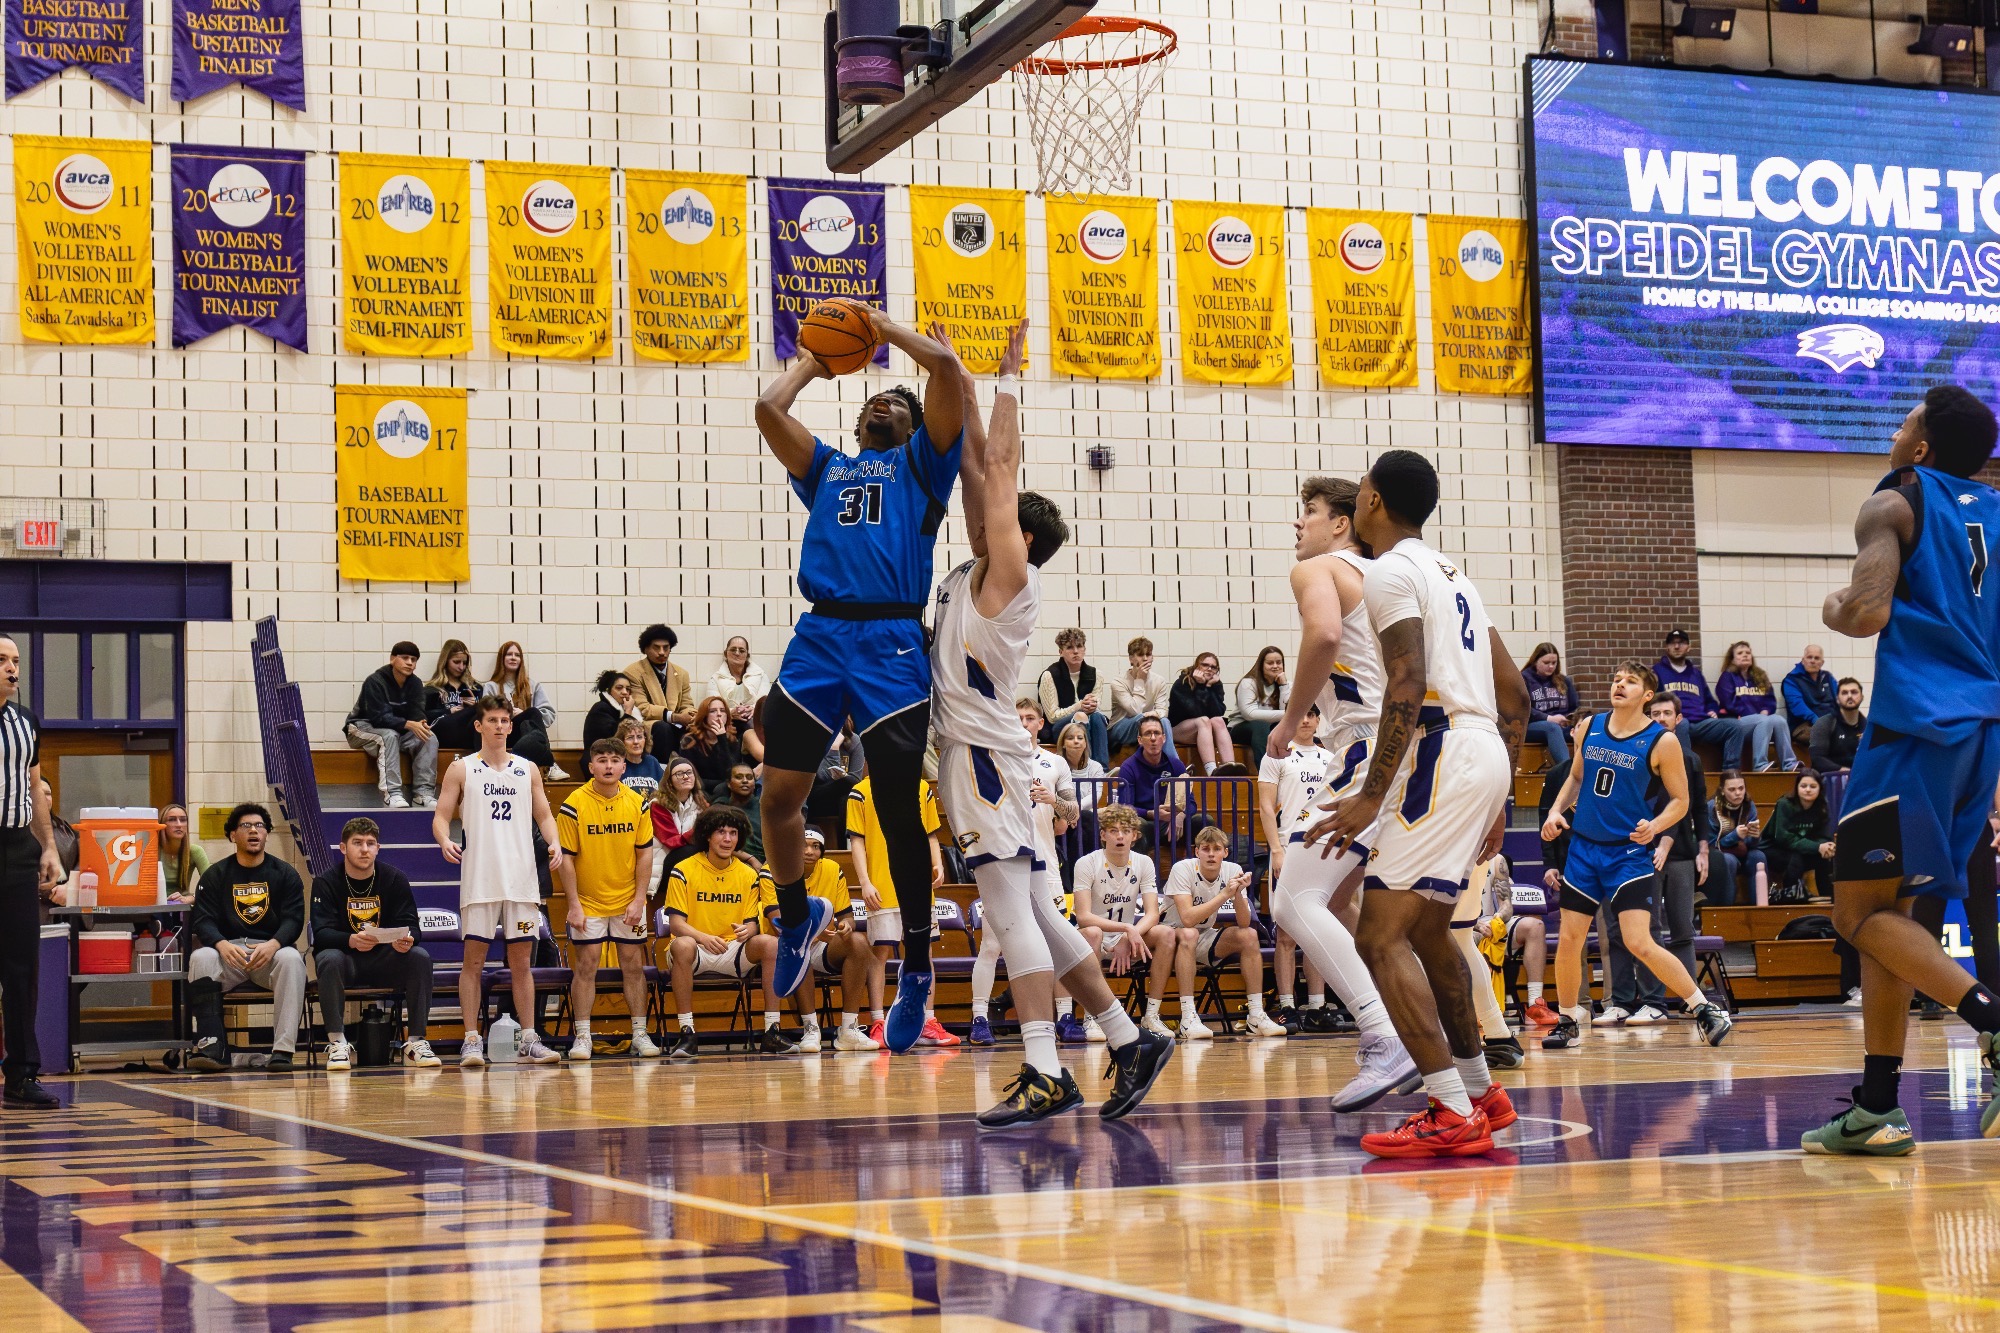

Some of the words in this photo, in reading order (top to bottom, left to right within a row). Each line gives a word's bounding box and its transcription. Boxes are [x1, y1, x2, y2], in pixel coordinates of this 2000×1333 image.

[22, 0, 129, 20] BASKETBALL
[24, 19, 101, 40] UPSTATE
[102, 23, 127, 42] NY
[187, 12, 289, 34] BASKETBALL
[17, 41, 133, 63] TOURNAMENT
[191, 31, 258, 55] UPSTATE
[258, 37, 283, 56] NY
[199, 54, 276, 75] FINALIST
[64, 171, 110, 186] avca
[25, 181, 51, 204] 20
[120, 186, 140, 207] 11
[218, 186, 262, 203] ECAC
[1623, 147, 1943, 231] WELCOME
[182, 189, 208, 213] 20
[273, 194, 296, 218] 12
[351, 198, 375, 220] 20
[440, 202, 460, 224] 12
[532, 197, 574, 210] avca
[497, 205, 520, 227] 20
[582, 209, 604, 231] 13
[636, 212, 659, 234] 20
[720, 216, 741, 238] 13
[809, 217, 847, 233] ECAC
[954, 214, 984, 224] UNITED
[44, 221, 121, 240] WOMEN'S
[195, 229, 282, 251] WOMEN'S
[777, 219, 799, 242] 20
[857, 223, 879, 246] 13
[921, 226, 942, 247] 20
[998, 230, 1020, 253] 14
[1088, 225, 1125, 239] avca
[1216, 231, 1252, 244] avca
[33, 241, 136, 262] VOLLEYBALL
[512, 244, 584, 263] WOMEN'S
[1056, 233, 1076, 254] 20
[1132, 238, 1151, 259] 14
[1183, 233, 1204, 253] 20
[1258, 236, 1280, 256] 15
[1317, 239, 1337, 259] 20
[1389, 241, 1407, 262] 15
[1348, 238, 1382, 250] avca
[1550, 215, 1769, 285] SPEIDEL
[181, 250, 297, 274] VOLLEYBALL
[364, 254, 449, 274] WOMEN'S
[790, 254, 867, 275] WOMEN'S
[1438, 256, 1457, 278] 20
[37, 262, 112, 283] DIVISION
[116, 266, 133, 284] III
[505, 264, 598, 284] VOLLEYBALL
[649, 269, 728, 288] WOMEN'S
[1082, 271, 1127, 288] MEN'S
[178, 272, 300, 296] TOURNAMENT
[351, 275, 462, 295] VOLLEYBALL
[508, 284, 576, 304] DIVISION
[580, 289, 595, 304] III
[777, 274, 880, 296] VOLLEYBALL
[947, 283, 994, 300] MEN'S
[1212, 276, 1257, 293] MEN'S
[1344, 281, 1389, 298] MEN'S
[24, 285, 145, 306] ALL-AMERICAN
[637, 288, 741, 309] VOLLEYBALL
[1062, 289, 1146, 308] VOLLEYBALL
[1193, 294, 1274, 312] VOLLEYBALL
[1643, 286, 1696, 308] HOME
[1696, 289, 1721, 309] OF
[1721, 291, 1753, 311] THE
[1754, 293, 1816, 315] ELMIRA
[1816, 295, 1891, 319] COLLEGE
[1891, 299, 1966, 322] SOARING
[25, 306, 61, 325] Sasha
[64, 309, 124, 327] Zavadska
[127, 310, 147, 327] '13
[201, 298, 279, 319] FINALIST
[350, 297, 464, 318] TOURNAMENT
[495, 304, 607, 324] ALL-AMERICAN
[812, 306, 847, 322] NCAA
[923, 301, 1022, 320] VOLLEYBALL
[1326, 299, 1405, 317] VOLLEYBALL
[1452, 304, 1518, 322] WOMEN'S
[634, 310, 745, 330] TOURNAMENT
[1068, 309, 1127, 327] DIVISION
[1130, 312, 1143, 327] III
[1197, 313, 1257, 330] DIVISION
[1260, 316, 1271, 331] III
[1329, 318, 1389, 335] DIVISION
[1391, 320, 1404, 336] III
[350, 319, 466, 339] SEMI-FINALIST
[499, 325, 533, 345] Taryn
[536, 328, 585, 348] Rumsey
[589, 329, 607, 344] '14
[1057, 327, 1154, 346] ALL-AMERICAN
[1442, 322, 1531, 342] VOLLEYBALL
[634, 330, 745, 351] SEMI-FINALIST
[1188, 332, 1284, 350] ALL-AMERICAN
[1322, 336, 1415, 354] ALL-AMERICAN
[1060, 348, 1094, 364] Michael
[1193, 350, 1227, 368] Robert
[1231, 353, 1261, 369] Shade
[1266, 353, 1284, 368] '15
[1439, 342, 1532, 361] TOURNAMENT
[1329, 355, 1351, 372] Erik
[1353, 356, 1391, 373] Griffin
[1459, 363, 1516, 380] FINALIST
[345, 425, 370, 448] 20
[435, 428, 458, 451] 17
[358, 485, 448, 503] BASEBALL
[838, 483, 882, 526] 31
[343, 507, 464, 526] TOURNAMENT
[24, 521, 58, 546] EXIT
[343, 530, 464, 548] SEMI-FINALIST
[1454, 592, 1475, 652] 2
[1585, 746, 1639, 770] HARTWICK
[483, 782, 518, 796] Elmira
[1594, 767, 1615, 797] 0
[491, 800, 511, 821] 22
[587, 822, 634, 835] ELMIRA
[113, 835, 136, 861] G
[237, 887, 265, 896] ELMIRA
[696, 892, 742, 903] ELMIRA
[1103, 893, 1131, 905] Elmira
[423, 920, 456, 928] COLLEGE
[424, 915, 454, 923] ELMIRA
[1106, 907, 1124, 922] 11
